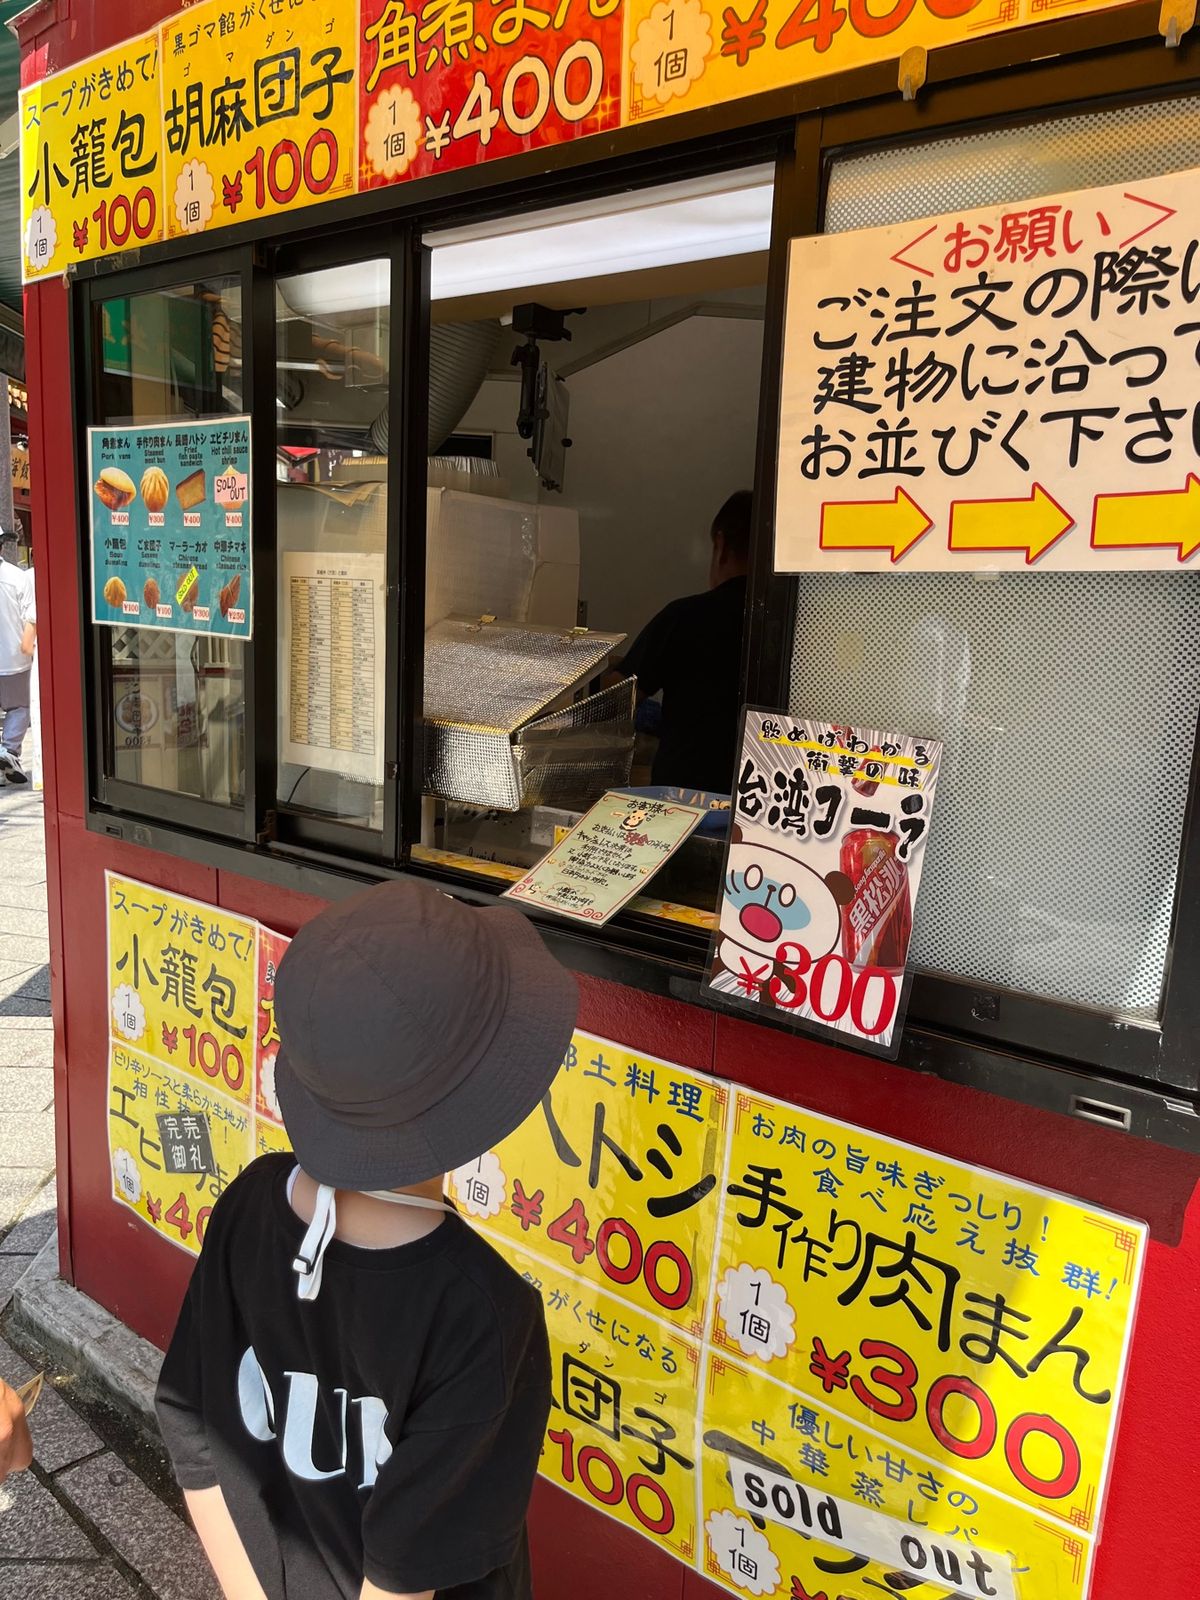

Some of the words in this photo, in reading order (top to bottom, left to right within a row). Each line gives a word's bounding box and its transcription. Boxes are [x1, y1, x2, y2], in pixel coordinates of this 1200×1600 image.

[165, 46, 356, 156] 胡麻団子
[424, 39, 605, 160] ¥400
[29, 110, 158, 206] 小籠包
[222, 127, 340, 214] ¥100
[73, 186, 157, 255] ¥100
[230, 487, 246, 500] OUT
[760, 720, 931, 766] 飲めばわかる
[806, 750, 922, 788] 衝撃の味
[738, 758, 925, 859] 台湾コーラ
[116, 933, 248, 1040] 小籠包
[737, 941, 896, 1036] ¥300
[162, 1021, 245, 1091] ¥100
[163, 1116, 202, 1141] 完売
[171, 1144, 207, 1171] 御礼
[512, 1178, 694, 1311] ¥400
[726, 1163, 1112, 1404] 手作り肉まん
[552, 1352, 695, 1475] 団子
[788, 1401, 979, 1517] 優しい甘さの
[810, 1336, 1082, 1500] ¥300
[541, 1428, 675, 1535] 100
[743, 1472, 844, 1541] sold
[899, 1533, 999, 1598] out
